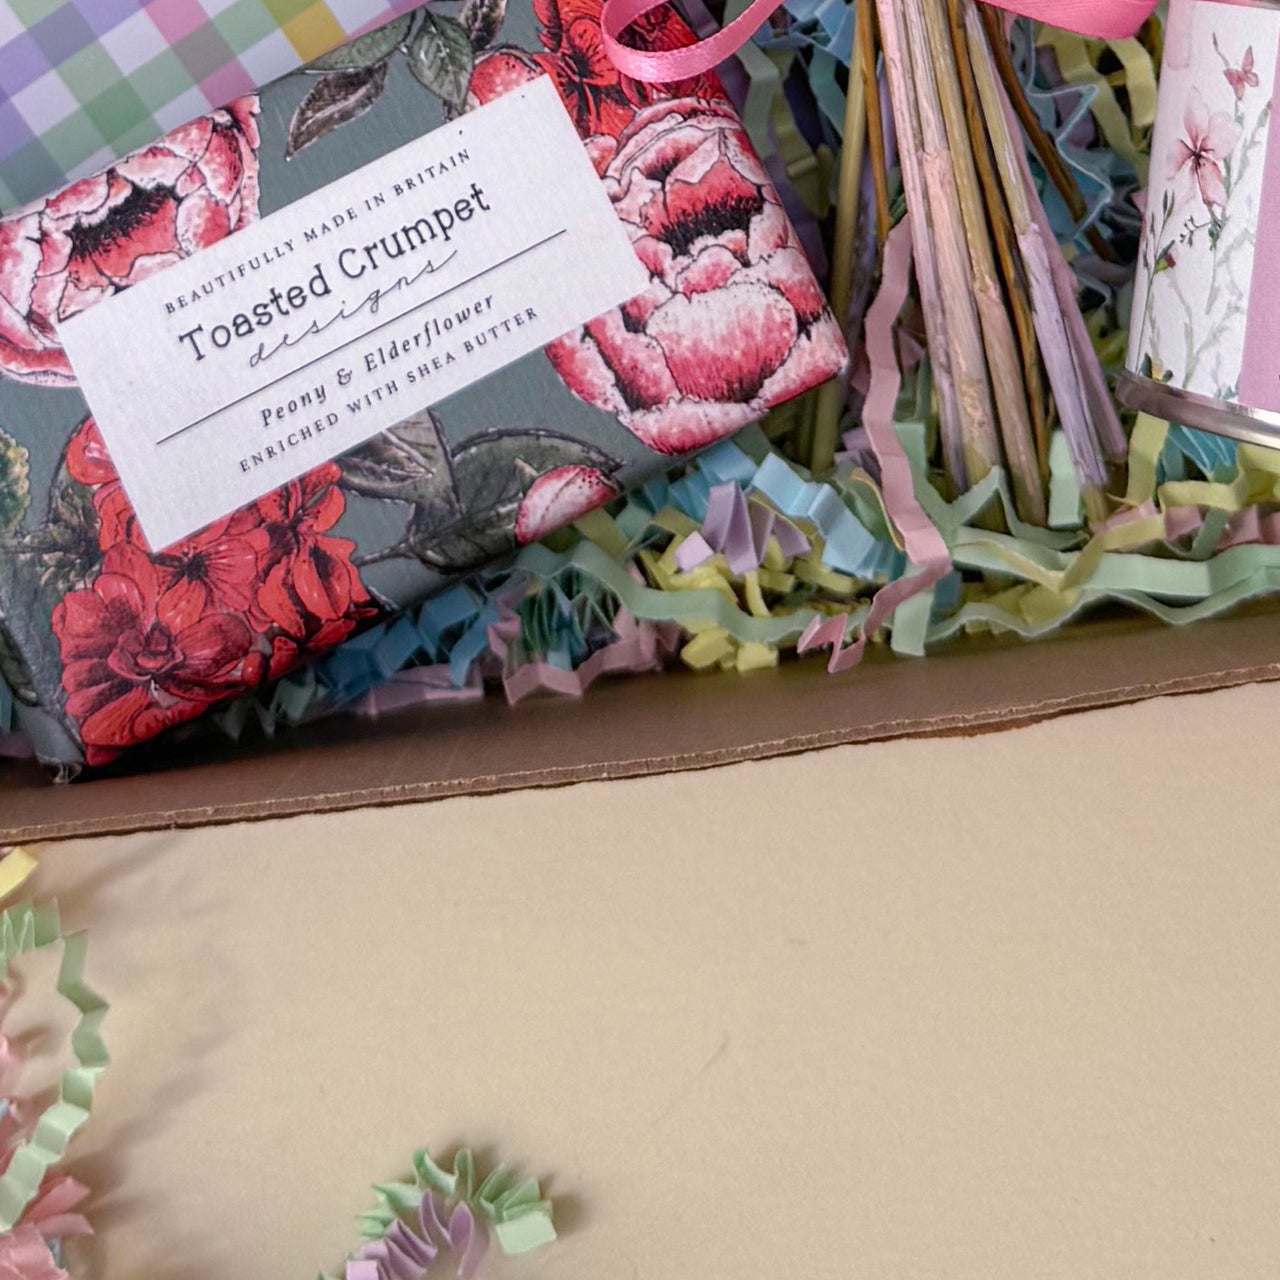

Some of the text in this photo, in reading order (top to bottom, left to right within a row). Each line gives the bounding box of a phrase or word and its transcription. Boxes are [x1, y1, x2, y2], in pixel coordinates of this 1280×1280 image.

[165, 149, 471, 315] BEAUTIFULLY MADE IN BRITAIN
[178, 182, 491, 361] Toasted Crumpet
[250, 250, 458, 367] designs
[240, 306, 538, 473] ENRICHED WITH SHEA BUTTER
[261, 294, 494, 427] Peony & Elderflower
